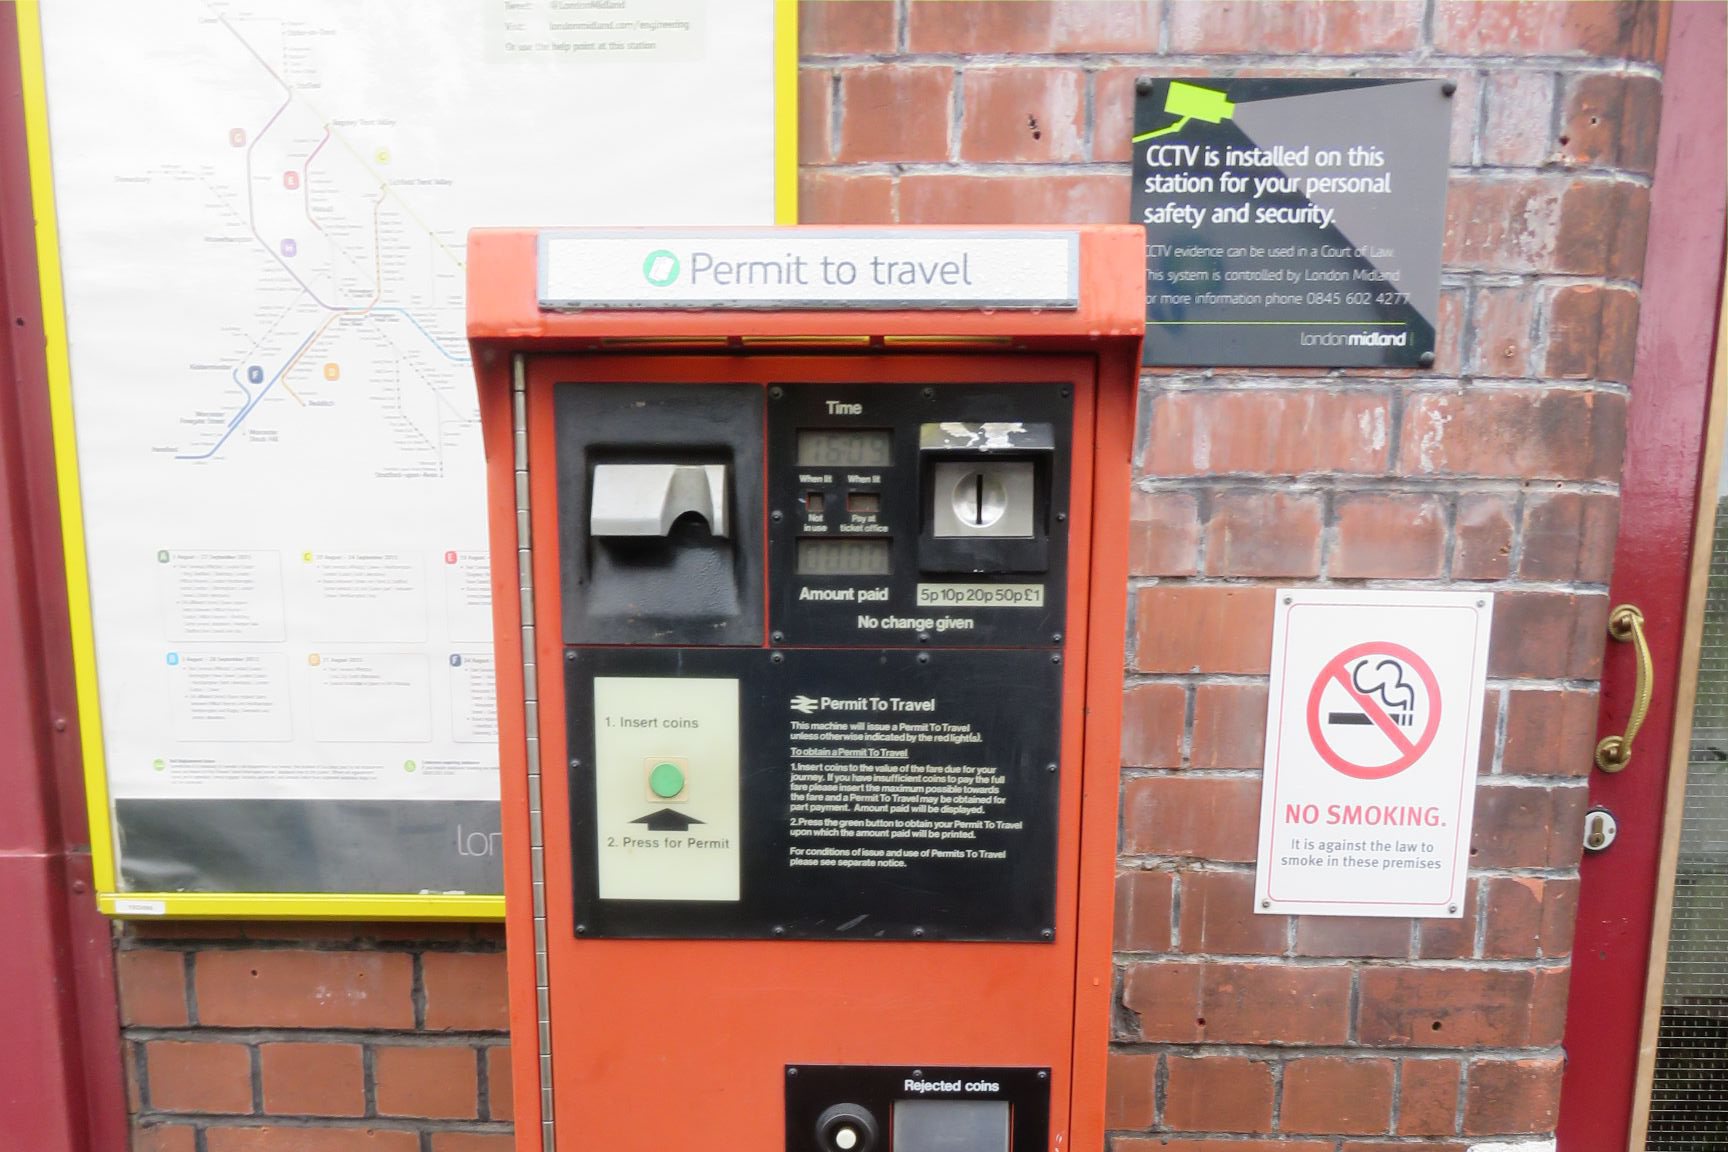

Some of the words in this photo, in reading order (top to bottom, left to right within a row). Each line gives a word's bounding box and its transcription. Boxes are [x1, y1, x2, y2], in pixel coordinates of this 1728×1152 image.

[552, 42, 571, 52] help
[573, 43, 595, 51] point
[1146, 145, 1200, 167] CCTV
[1204, 146, 1219, 167] is
[1225, 145, 1309, 167] installed
[1315, 150, 1341, 167] on
[1347, 146, 1384, 167] this
[1145, 174, 1213, 193] station
[1219, 172, 1249, 193] for
[1253, 177, 1300, 198] your
[1306, 173, 1392, 198] personal
[1144, 202, 1206, 229] safety
[1211, 203, 1249, 223] and
[1255, 204, 1336, 229] security.
[1174, 245, 1224, 258] evidence
[1226, 247, 1247, 258] can
[1249, 245, 1265, 257] be
[1267, 245, 1295, 257] used
[1297, 245, 1308, 257] in
[1311, 248, 1319, 257] a
[1320, 245, 1352, 258] Court
[1354, 245, 1368, 257] of
[690, 252, 808, 286] Permit
[820, 254, 856, 286] to
[870, 253, 972, 286] travel
[1167, 270, 1209, 284] system
[1212, 270, 1221, 281] is
[1224, 268, 1283, 281] controlled
[1286, 269, 1302, 284] by
[1305, 268, 1349, 281] London
[1353, 268, 1400, 281] Midland
[1160, 295, 1192, 304] more
[1194, 292, 1261, 304] information
[1265, 292, 1303, 307] phone
[1306, 292, 1341, 304] 0845
[1345, 292, 1372, 304] 602
[1375, 292, 1410, 304] 4277
[1300, 331, 1407, 346] londonmidland
[825, 400, 863, 415] Time
[799, 474, 822, 484] When
[823, 474, 833, 484] lit
[848, 474, 871, 484] When
[872, 474, 881, 484] lit
[808, 514, 823, 522] Not
[851, 514, 866, 524] Pay
[867, 514, 876, 522] at
[803, 524, 811, 532] in
[840, 524, 863, 532] ticket
[864, 524, 889, 533] office
[799, 587, 855, 601] Amount
[858, 587, 889, 603] paid
[920, 589, 939, 603] 5p
[941, 589, 964, 603] 10p
[966, 589, 993, 603] 20p
[995, 589, 1022, 603] 50p
[1024, 588, 1041, 601] £1
[858, 615, 879, 629] No
[880, 616, 934, 631] change
[936, 616, 974, 631] given
[820, 697, 868, 711] Permit
[870, 697, 888, 711] To
[889, 698, 935, 712] Travel
[605, 716, 616, 728] 1.
[620, 717, 658, 728] Insert
[662, 717, 699, 728] coins
[790, 721, 810, 731] This
[810, 721, 848, 731] machine
[849, 721, 866, 731] will
[867, 722, 890, 732] issue
[891, 724, 898, 732] a
[899, 722, 929, 732] Permit
[930, 723, 941, 732] To
[942, 723, 970, 732] Travel
[790, 747, 802, 757] To
[803, 747, 831, 757] obtain
[838, 748, 867, 757] Permit
[868, 748, 880, 758] To
[881, 748, 908, 758] Travel
[1285, 803, 1320, 825] NO
[1325, 804, 1447, 827] SMOKING.
[824, 818, 838, 827] the
[839, 820, 865, 829] green
[865, 818, 894, 828] button
[894, 819, 904, 828] to
[904, 819, 933, 828] obtain
[933, 821, 953, 830] your
[954, 820, 984, 829] Permit
[984, 820, 996, 829] To
[996, 820, 1023, 829] Travel
[789, 829, 812, 838] upon
[813, 828, 839, 837] which
[840, 828, 855, 838] the
[855, 829, 890, 838] amount
[890, 829, 911, 839] paid
[911, 829, 927, 838] will
[928, 829, 941, 838] be
[941, 830, 977, 840] printed.
[607, 837, 619, 847] 2.
[622, 837, 659, 848] Press
[664, 837, 682, 848] for
[687, 838, 730, 849] Permit
[1290, 838, 1300, 850] It
[1303, 838, 1315, 850] is
[1318, 839, 1366, 853] against
[1370, 839, 1391, 852] the
[1395, 840, 1417, 853] law
[1421, 841, 1434, 853] to
[790, 846, 805, 856] For
[805, 847, 850, 857] conditions
[851, 848, 861, 857] of
[861, 848, 885, 857] issue
[885, 848, 903, 858] and
[903, 850, 919, 858] use
[920, 848, 930, 857] of
[931, 849, 965, 858] Permits
[966, 849, 978, 858] To
[978, 849, 1006, 859] Travel
[790, 857, 819, 867] please
[820, 859, 836, 867] see
[837, 858, 876, 868] separate
[877, 858, 908, 868] notice.
[1280, 855, 1323, 867] smoke
[1327, 855, 1339, 867] in
[1343, 856, 1379, 868] these
[1382, 857, 1442, 870] premises
[904, 1079, 961, 1093] Rejected
[965, 1080, 1000, 1092] coins
